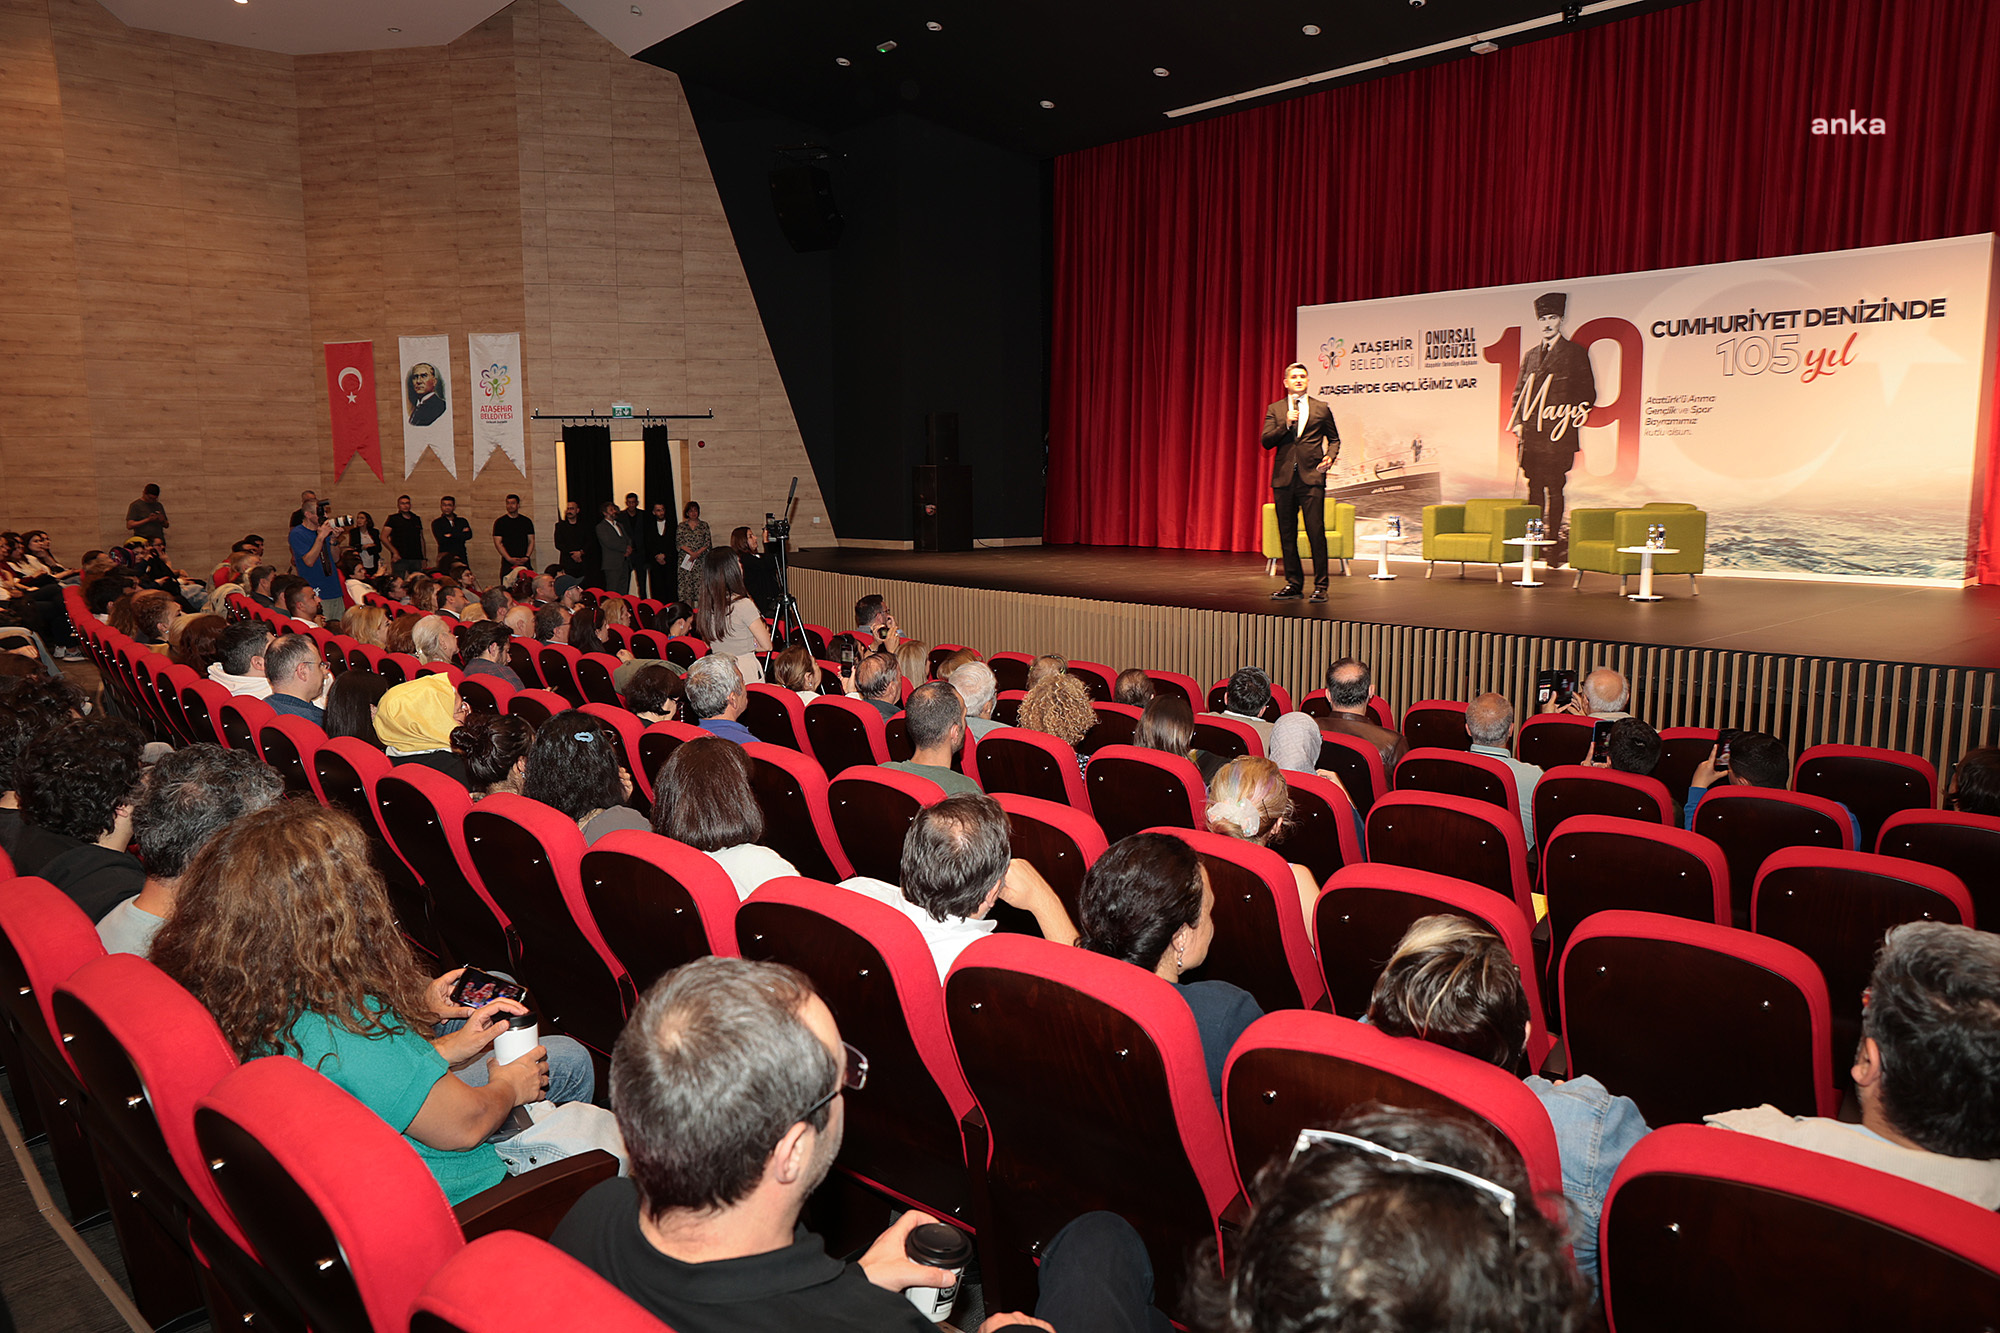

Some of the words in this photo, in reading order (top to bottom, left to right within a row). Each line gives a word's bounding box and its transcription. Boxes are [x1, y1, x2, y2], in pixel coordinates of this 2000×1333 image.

[1650, 308, 1801, 338] CUMHURİYET
[1803, 296, 1947, 328] DENİZİNDE
[1424, 327, 1476, 345] ONURSAL
[1350, 336, 1413, 356] ATAŞEHİR
[1424, 343, 1478, 361] ADIGÜZEL
[1349, 353, 1415, 371] BELEDİYESİ
[1715, 333, 1800, 377] 105
[1800, 331, 1859, 384] yıl
[1382, 376, 1453, 394] GENÇLİĞİMİZ
[1454, 377, 1478, 389] VAR
[1505, 372, 1593, 442] Mayıs
